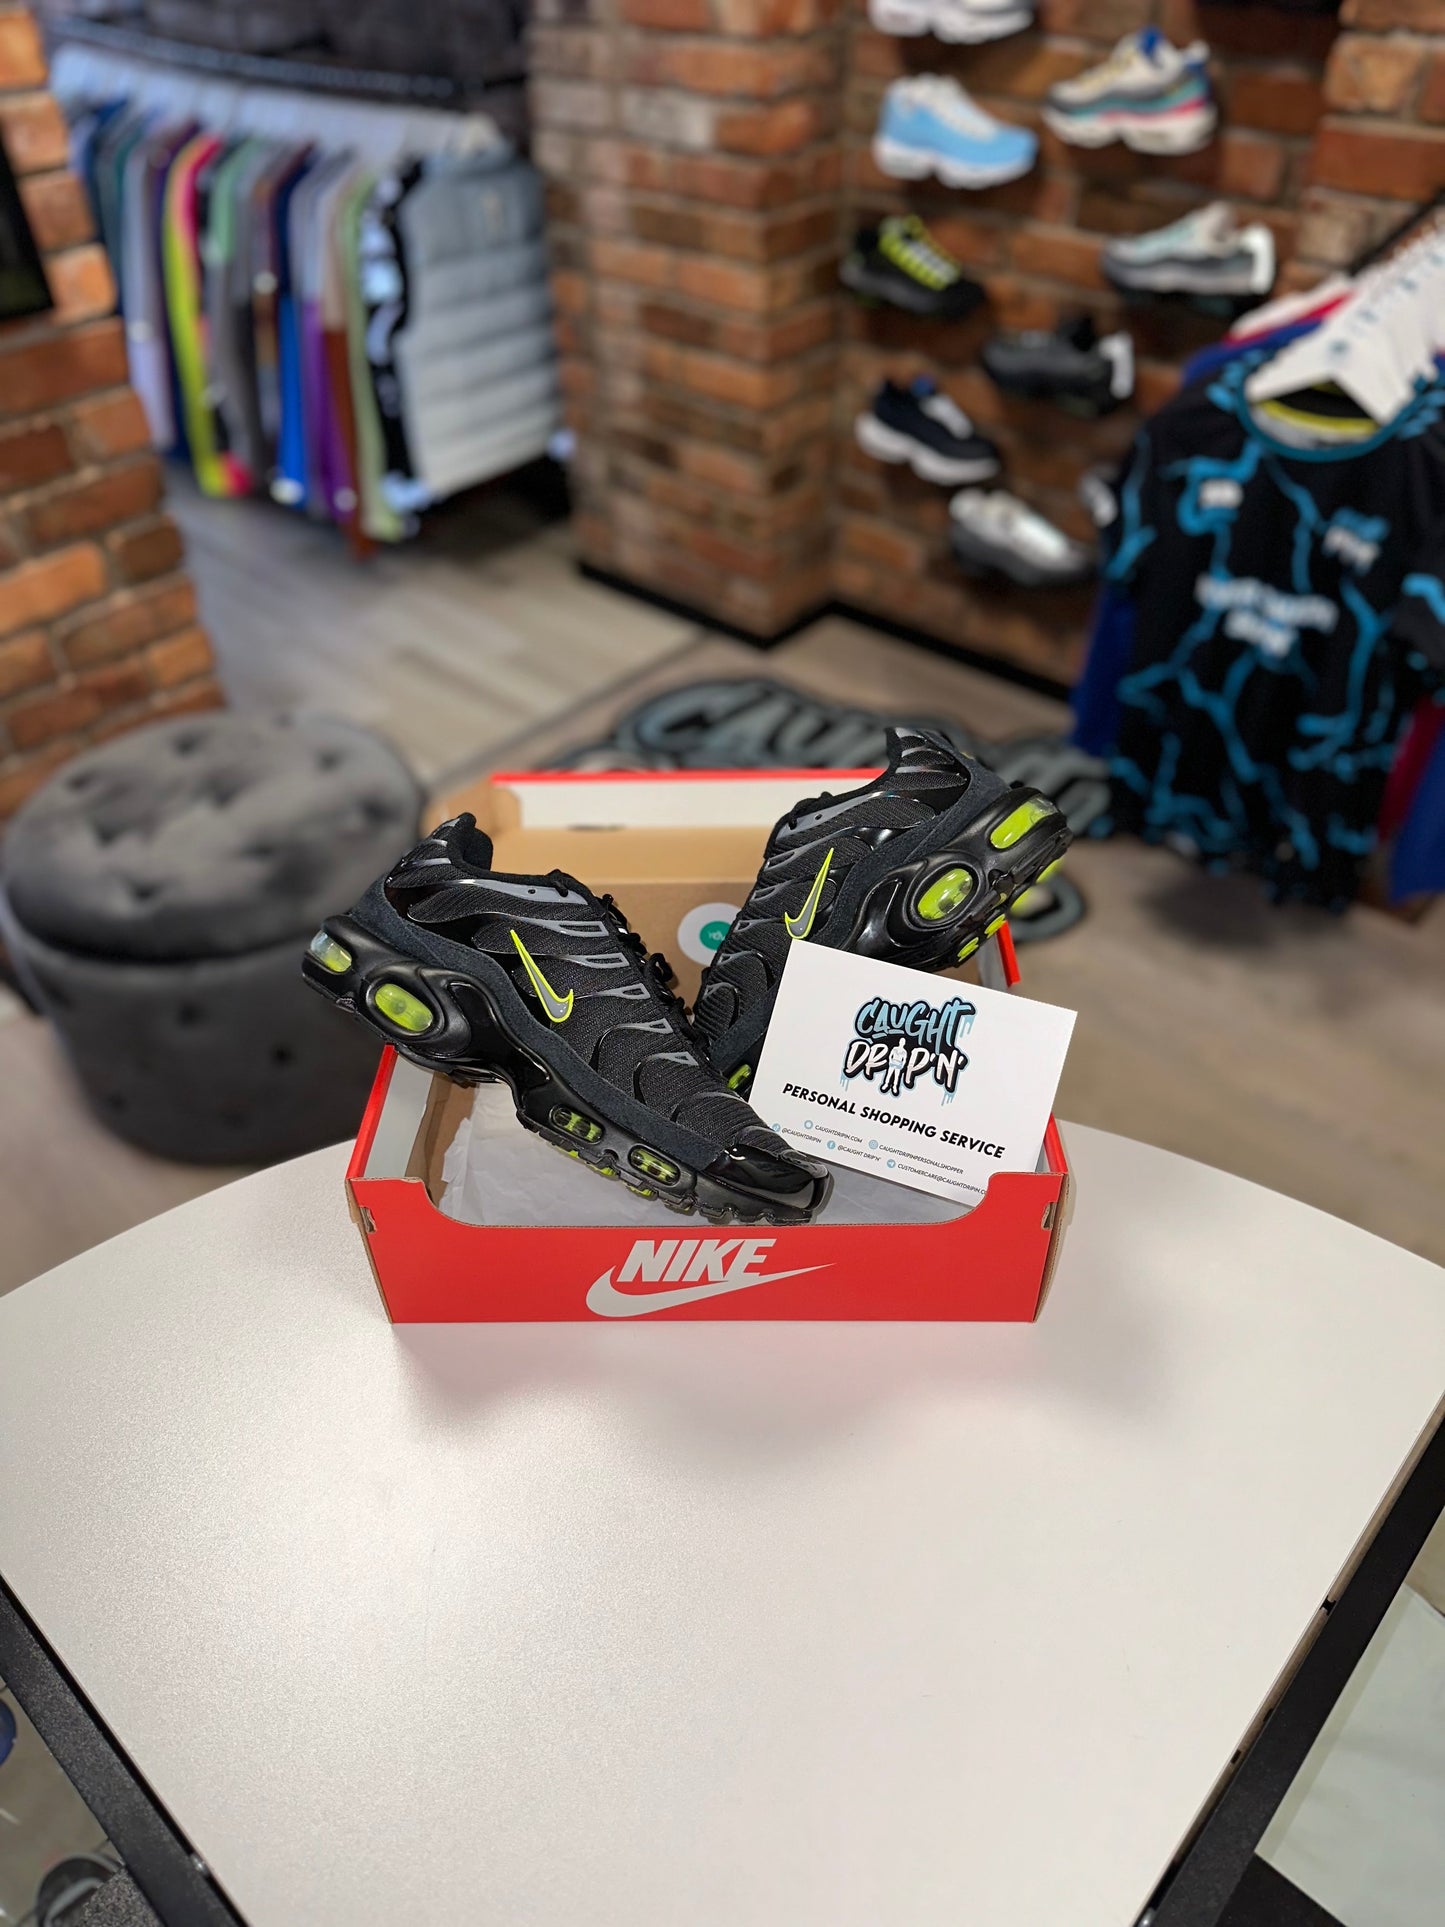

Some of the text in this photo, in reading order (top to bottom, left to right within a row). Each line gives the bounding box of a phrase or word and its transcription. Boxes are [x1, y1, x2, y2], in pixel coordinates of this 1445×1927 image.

[855, 997, 974, 1055] CAUGHT
[782, 1083, 1006, 1159] PERSONAL SHOPPING SERVICE
[814, 1124, 863, 1143] CAUGHTDRIPIN.COM
[616, 1238, 777, 1283] NIKE
